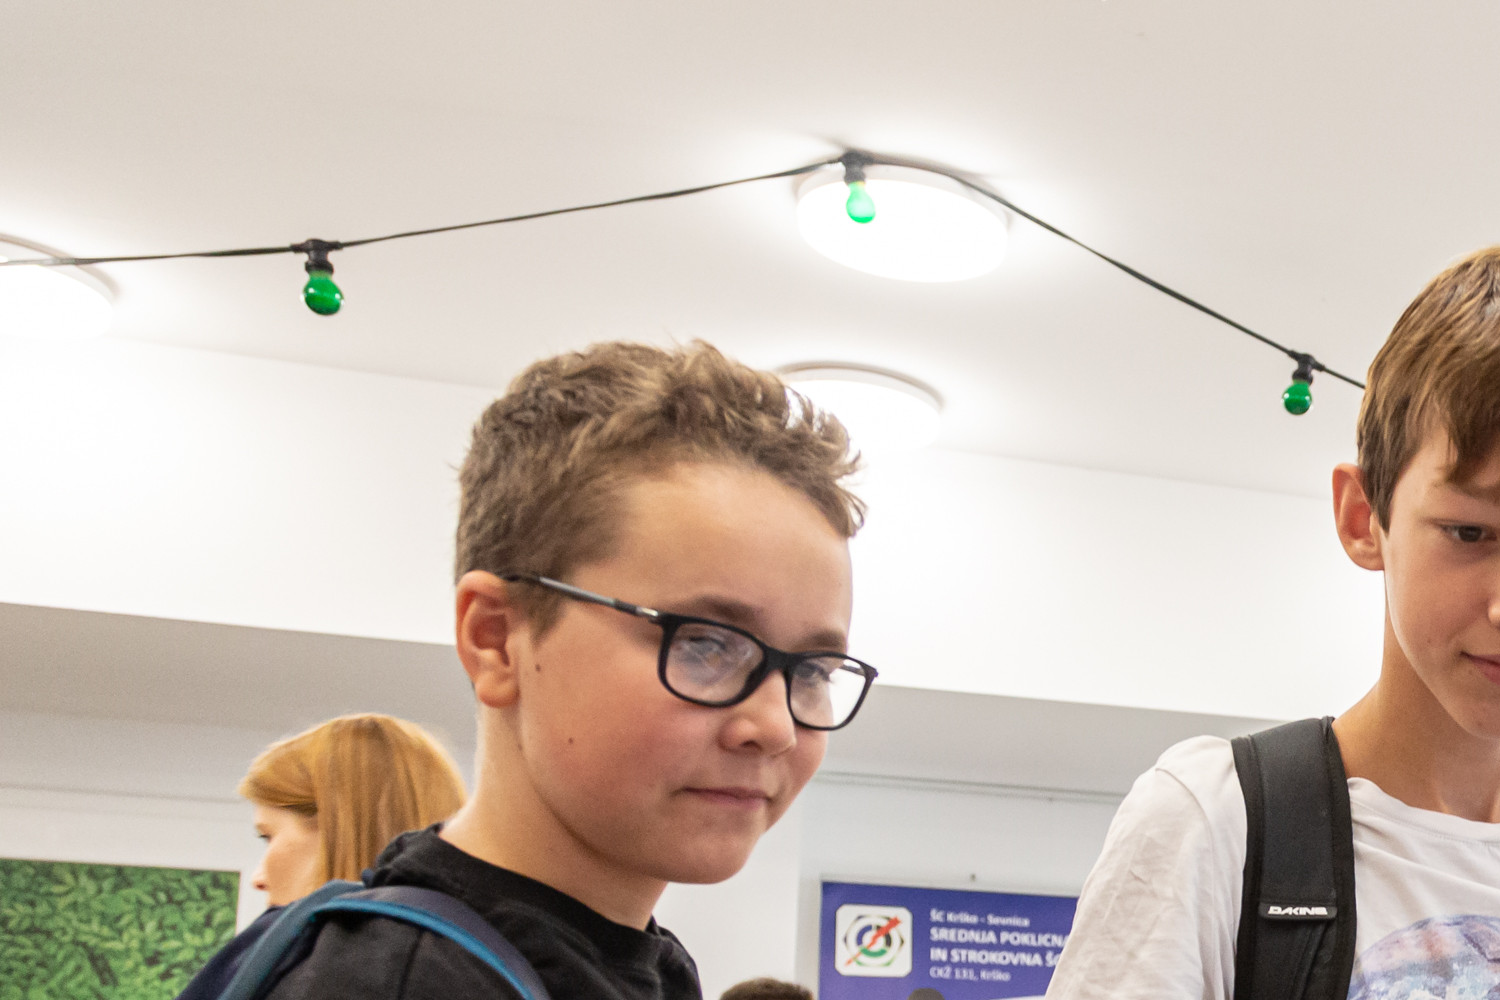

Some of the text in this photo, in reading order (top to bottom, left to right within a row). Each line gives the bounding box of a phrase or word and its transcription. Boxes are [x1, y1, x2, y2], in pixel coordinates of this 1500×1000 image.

[1268, 905, 1328, 915] DAKINE
[947, 911, 979, 925] Krško
[986, 914, 1030, 928] Sevnica
[930, 927, 997, 944] SREDNJA
[930, 947, 947, 962] IN
[950, 948, 1043, 967] STROKOVNA
[930, 965, 951, 979] CKŽ
[980, 969, 1011, 982] Krško
